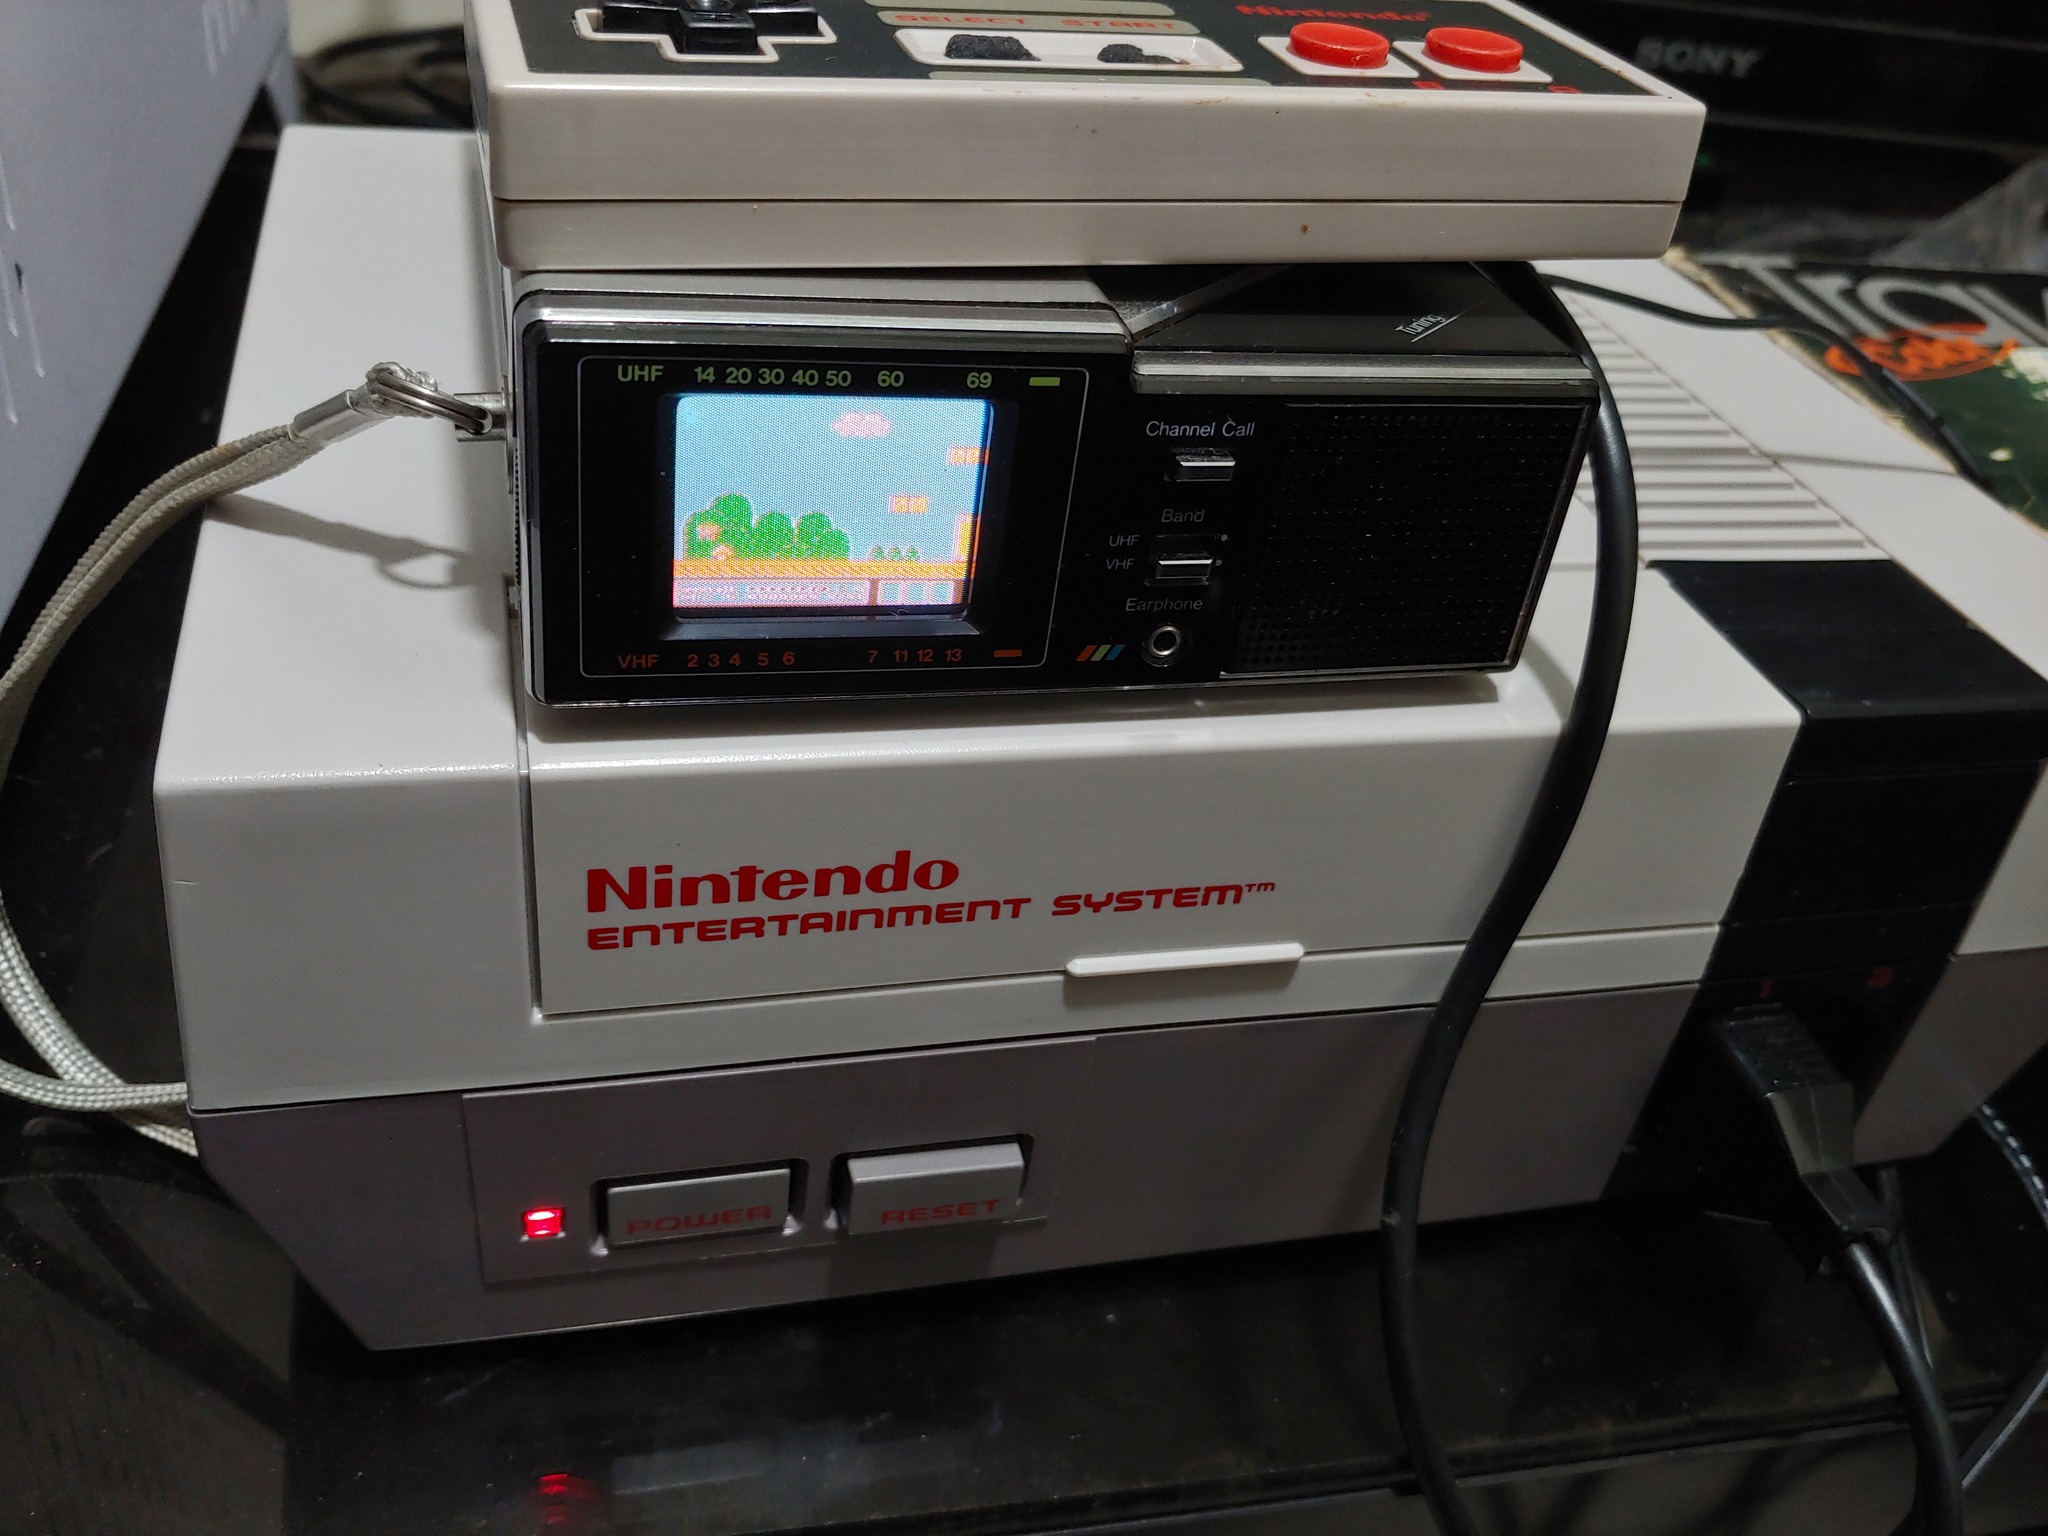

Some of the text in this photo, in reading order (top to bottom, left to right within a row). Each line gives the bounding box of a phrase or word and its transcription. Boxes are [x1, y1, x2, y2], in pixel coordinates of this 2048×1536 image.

[894, 14, 1175, 30] SELECT START
[1634, 34, 1761, 79] SONY
[1394, 313, 1446, 335] Tuning
[617, 364, 993, 389] UHF 14 20 30 40 50 60 69
[1145, 420, 1256, 438] Channel Call
[1160, 508, 1206, 524] Band
[1108, 534, 1140, 547] UHF
[1105, 558, 1136, 570] VHF
[1124, 598, 1204, 613] Earphone
[617, 648, 962, 669] VHF 2 3 4 5 6 7 11 12 13
[586, 849, 960, 913] Nintendo
[587, 896, 1033, 951] ENTERTAINMENT
[626, 1204, 774, 1235] POWER
[880, 1198, 1000, 1226] RESET
